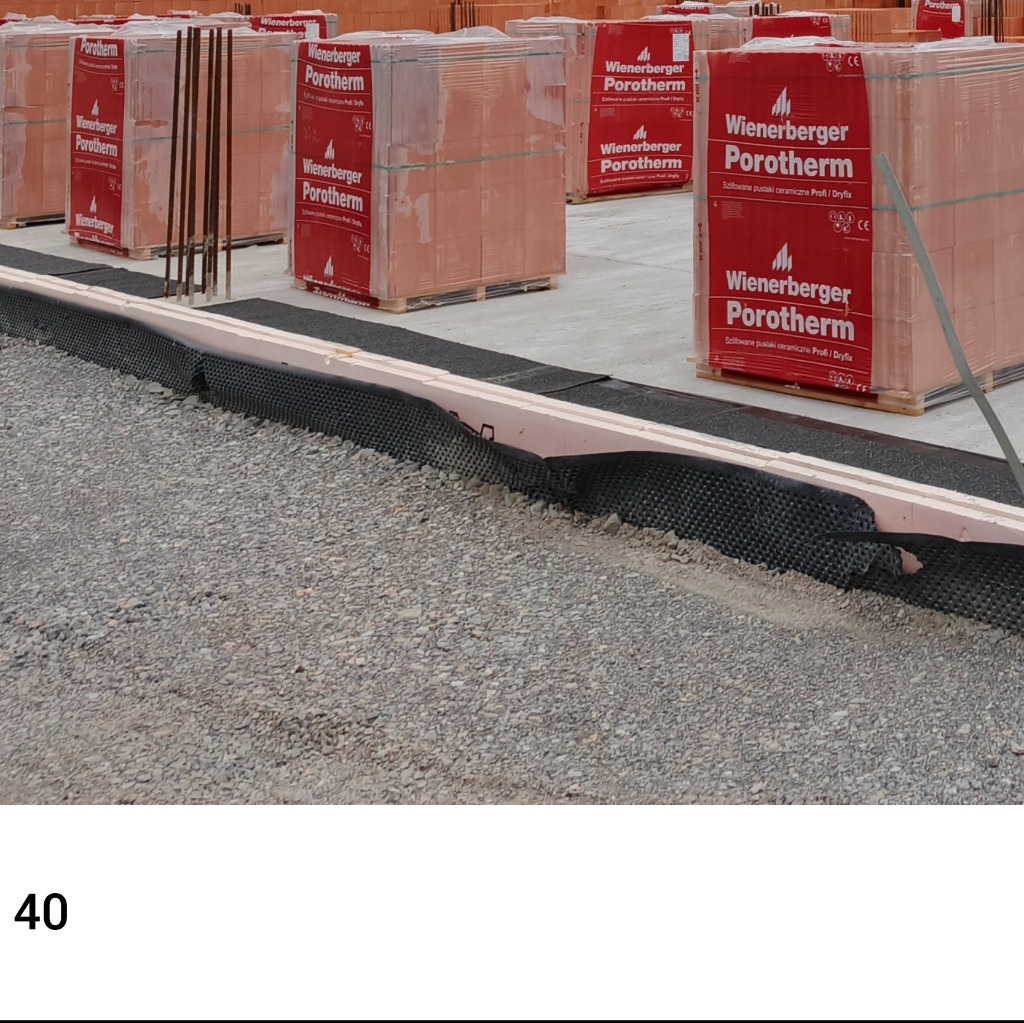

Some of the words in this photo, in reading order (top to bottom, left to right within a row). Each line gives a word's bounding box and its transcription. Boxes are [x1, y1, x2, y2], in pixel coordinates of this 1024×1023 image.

[80, 37, 118, 57] Porotherm
[308, 43, 361, 67] Wienerberger
[305, 64, 365, 91] Porotherm
[606, 61, 684, 75] Wienerberger
[604, 77, 686, 92] Porotherm
[725, 113, 849, 146] Wienerberger
[76, 134, 118, 157] Porotherm
[601, 141, 682, 156] Wienerberger
[303, 158, 363, 185] Wienerberger
[601, 156, 683, 173] Porotherm
[725, 145, 854, 178] Porotherm
[303, 181, 363, 212] Porotherm
[811, 189, 827, 198] Profi
[832, 190, 852, 200] Dryfix
[726, 270, 852, 305] Wienerberger
[726, 301, 855, 341] Porotherm
[812, 347, 828, 357] Profi
[833, 350, 853, 362] Dryfix
